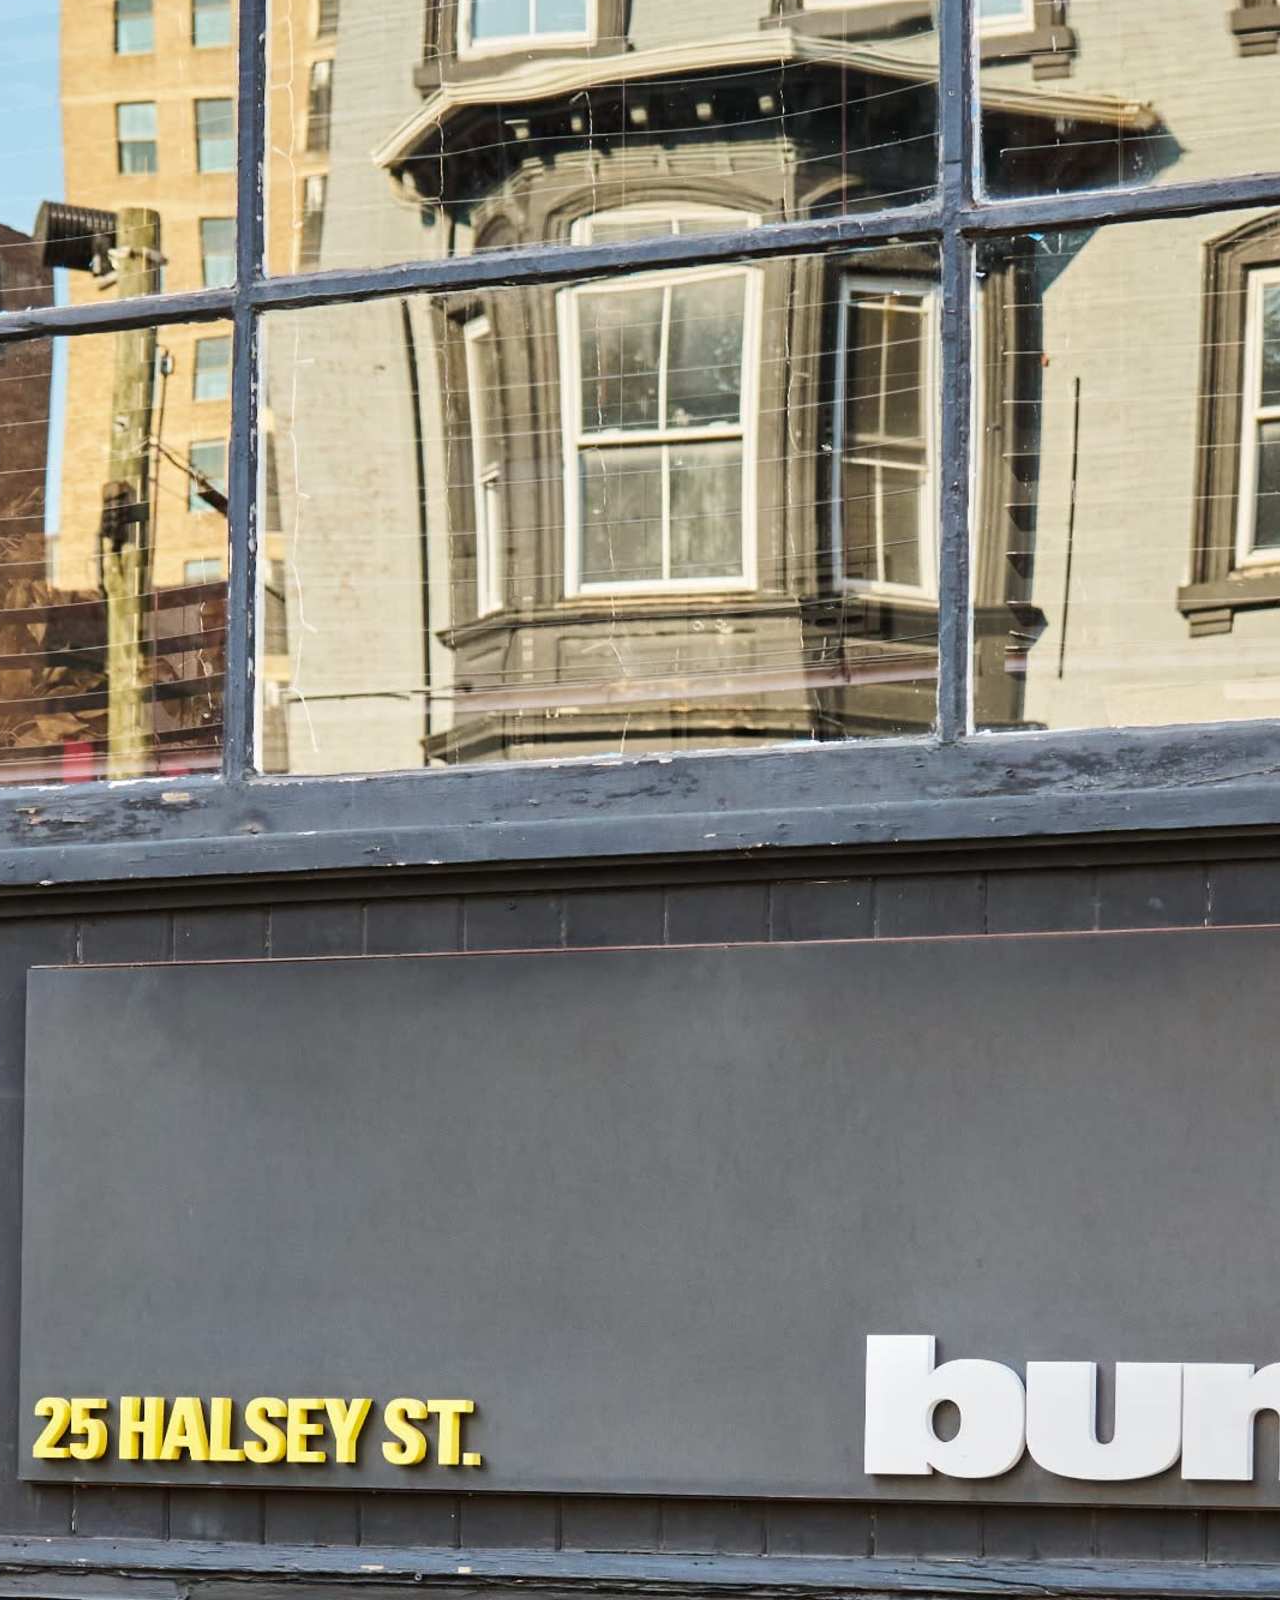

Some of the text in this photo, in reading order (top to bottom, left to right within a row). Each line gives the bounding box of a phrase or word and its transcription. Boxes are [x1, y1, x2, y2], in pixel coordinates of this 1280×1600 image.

[32, 1396, 482, 1466] 25 HALSEY ST.
